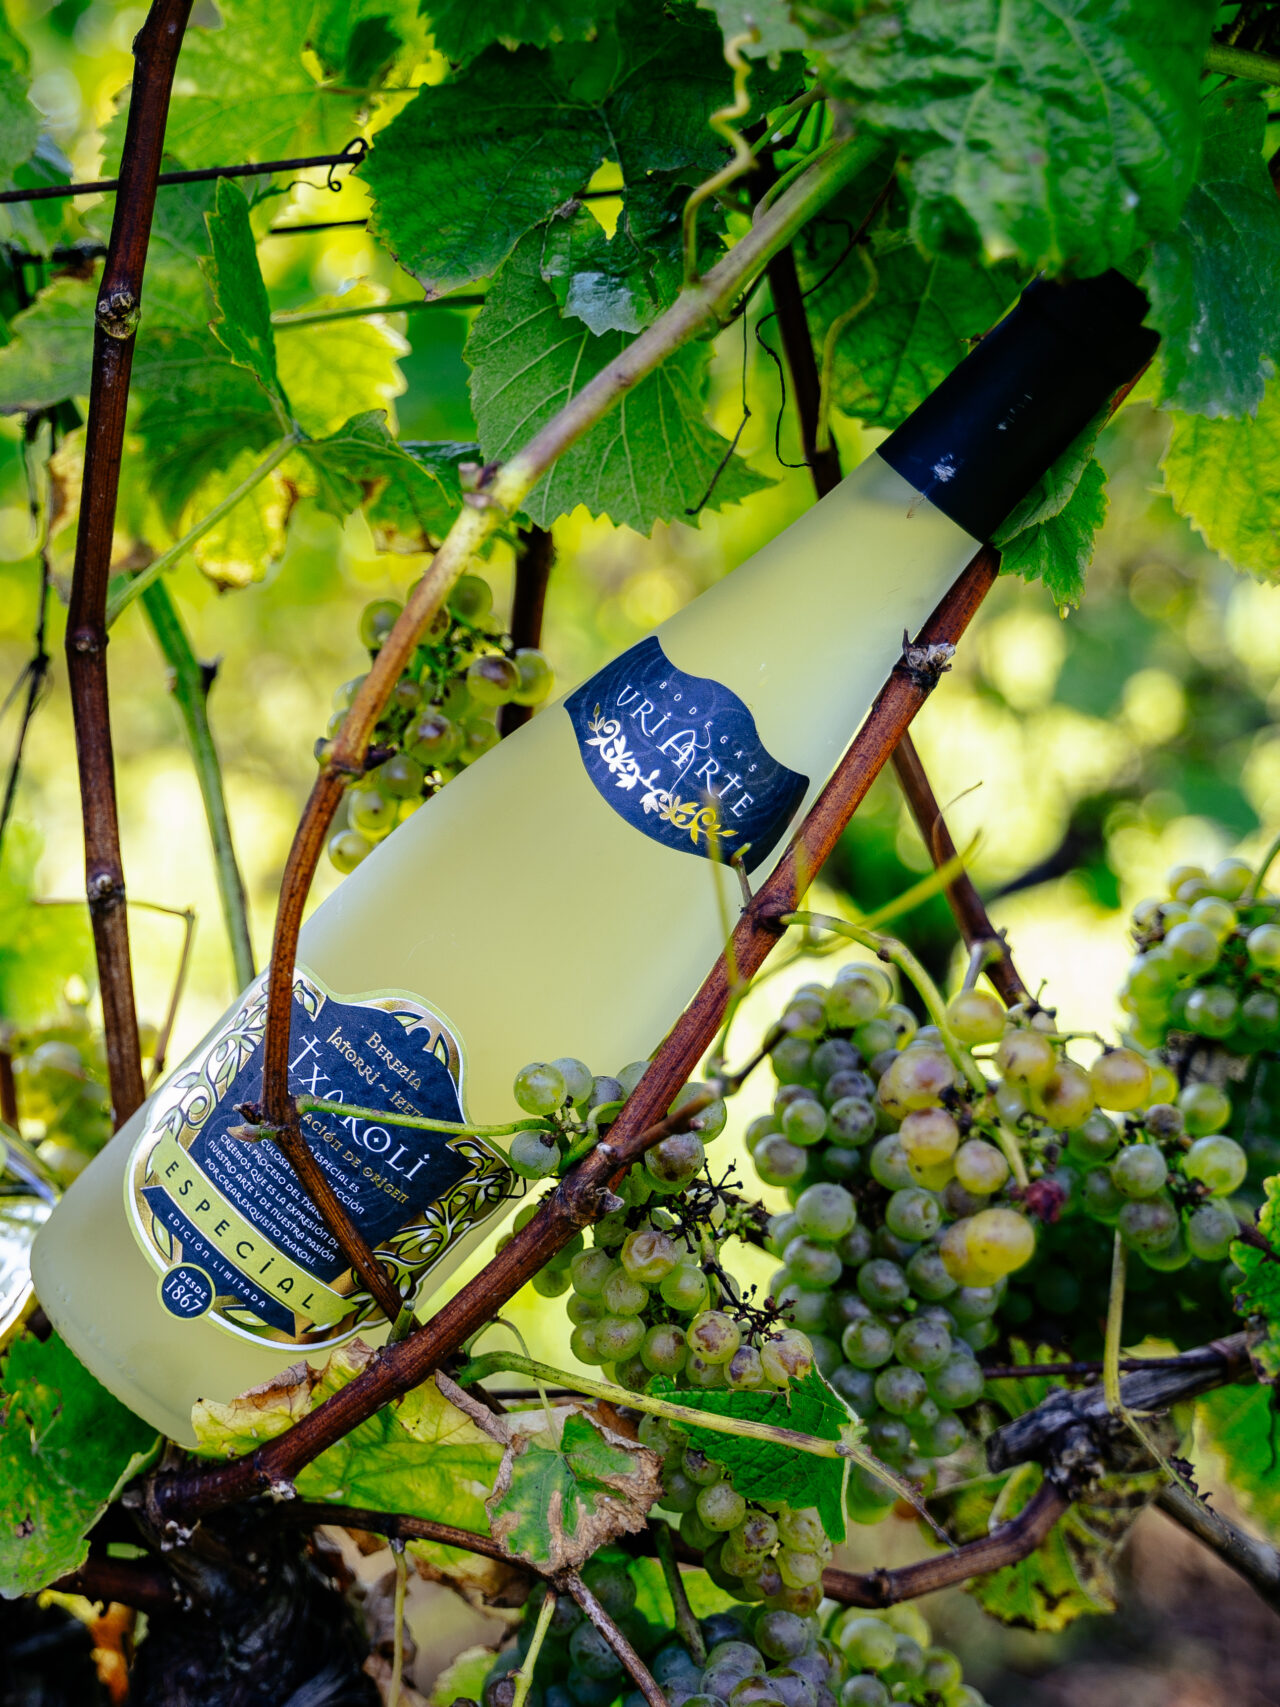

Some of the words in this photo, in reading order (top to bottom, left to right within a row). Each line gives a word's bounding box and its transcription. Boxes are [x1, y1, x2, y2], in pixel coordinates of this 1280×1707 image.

[658, 681, 757, 773] BODEGAS
[204, 1158, 219, 1180] POR
[218, 1174, 241, 1204] CREAR
[240, 1198, 281, 1237] EXQUISITO
[208, 1140, 236, 1174] NUESTRO
[235, 1173, 254, 1193] ARTE
[254, 1189, 262, 1199] Y
[259, 1197, 272, 1210] DE
[270, 1207, 305, 1240] NUESTRA
[304, 1237, 336, 1263] PASIÓN
[220, 1134, 252, 1170] CREEMOS
[250, 1169, 267, 1187] QUE
[265, 1184, 277, 1195] ES
[275, 1192, 286, 1205] LA
[285, 1202, 329, 1240] EXPRESIÓN
[250, 1149, 286, 1185] PROCESO
[285, 1183, 300, 1201] DEL
[342, 1150, 362, 1168] DE
[363, 1166, 411, 1204] ORIGEN
[165, 1161, 314, 1310] ESPECIAL
[168, 1212, 209, 1259] EDICIÓN
[213, 1260, 266, 1308] LIMITADA
[164, 1278, 203, 1313] 1867
[178, 1270, 208, 1299] DESDE
